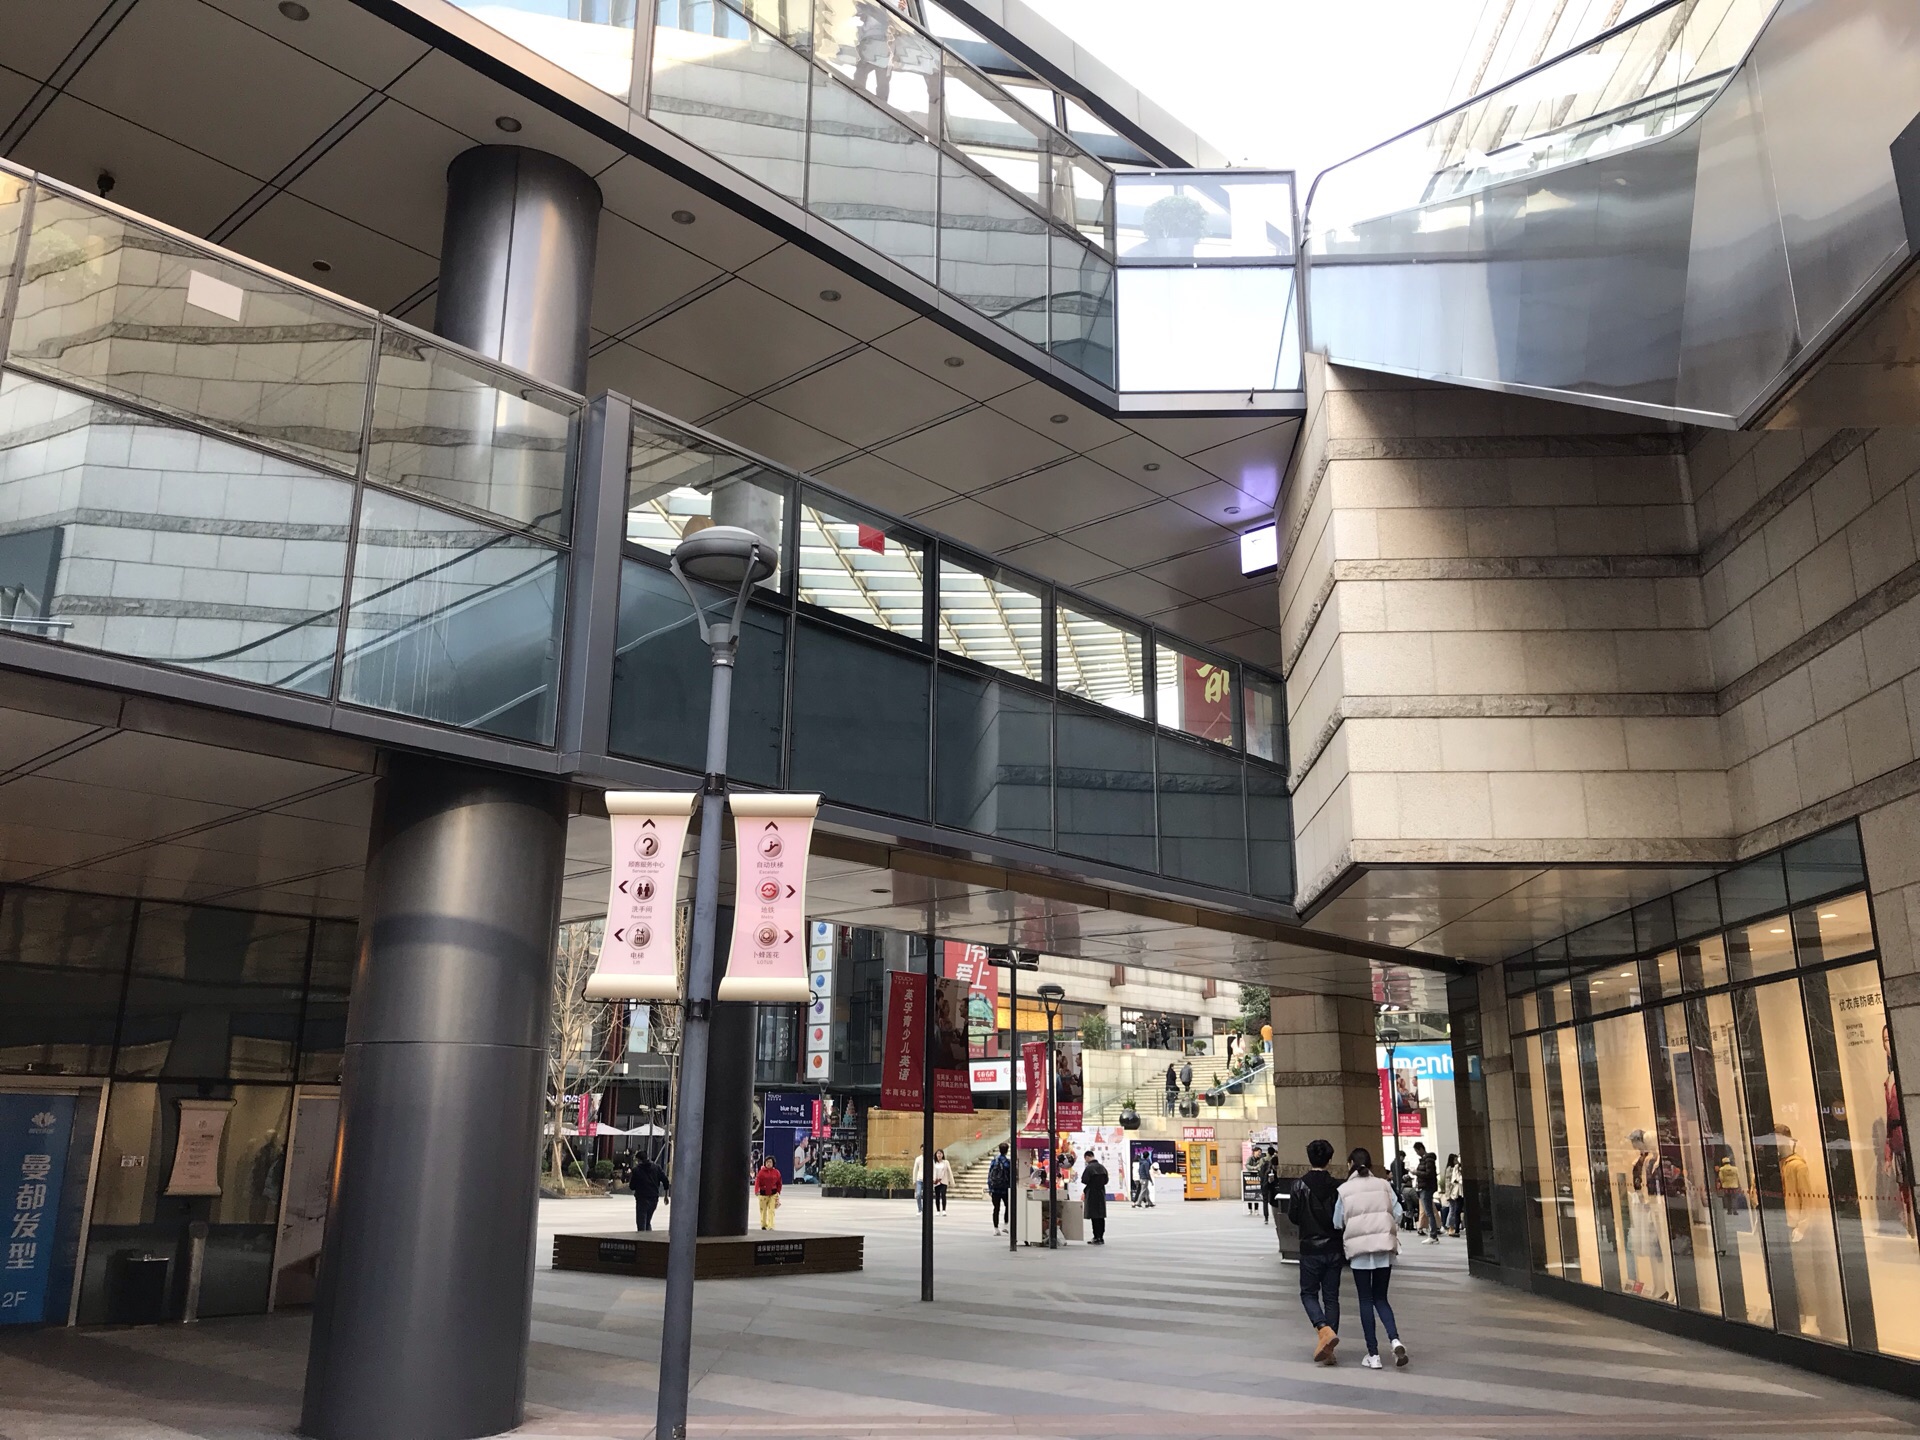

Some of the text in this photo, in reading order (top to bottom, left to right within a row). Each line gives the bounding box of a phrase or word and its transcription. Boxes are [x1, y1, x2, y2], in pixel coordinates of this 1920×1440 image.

[628, 861, 665, 869] 顾客服务中心
[756, 861, 784, 869] 自动扶梯
[631, 905, 653, 913] 洗手间
[761, 906, 775, 914] 地铁
[753, 951, 780, 959] 卜蜂莲花
[938, 979, 951, 989] EF
[1839, 993, 1883, 1012] 优衣库防晒衣
[898, 988, 915, 1081] 英孚青少儿英语
[779, 1104, 800, 1114] blue frog
[1183, 1128, 1214, 1138] MR.WISH
[5, 1153, 52, 1270] 曼都发型
[1, 1290, 28, 1309] 2F
